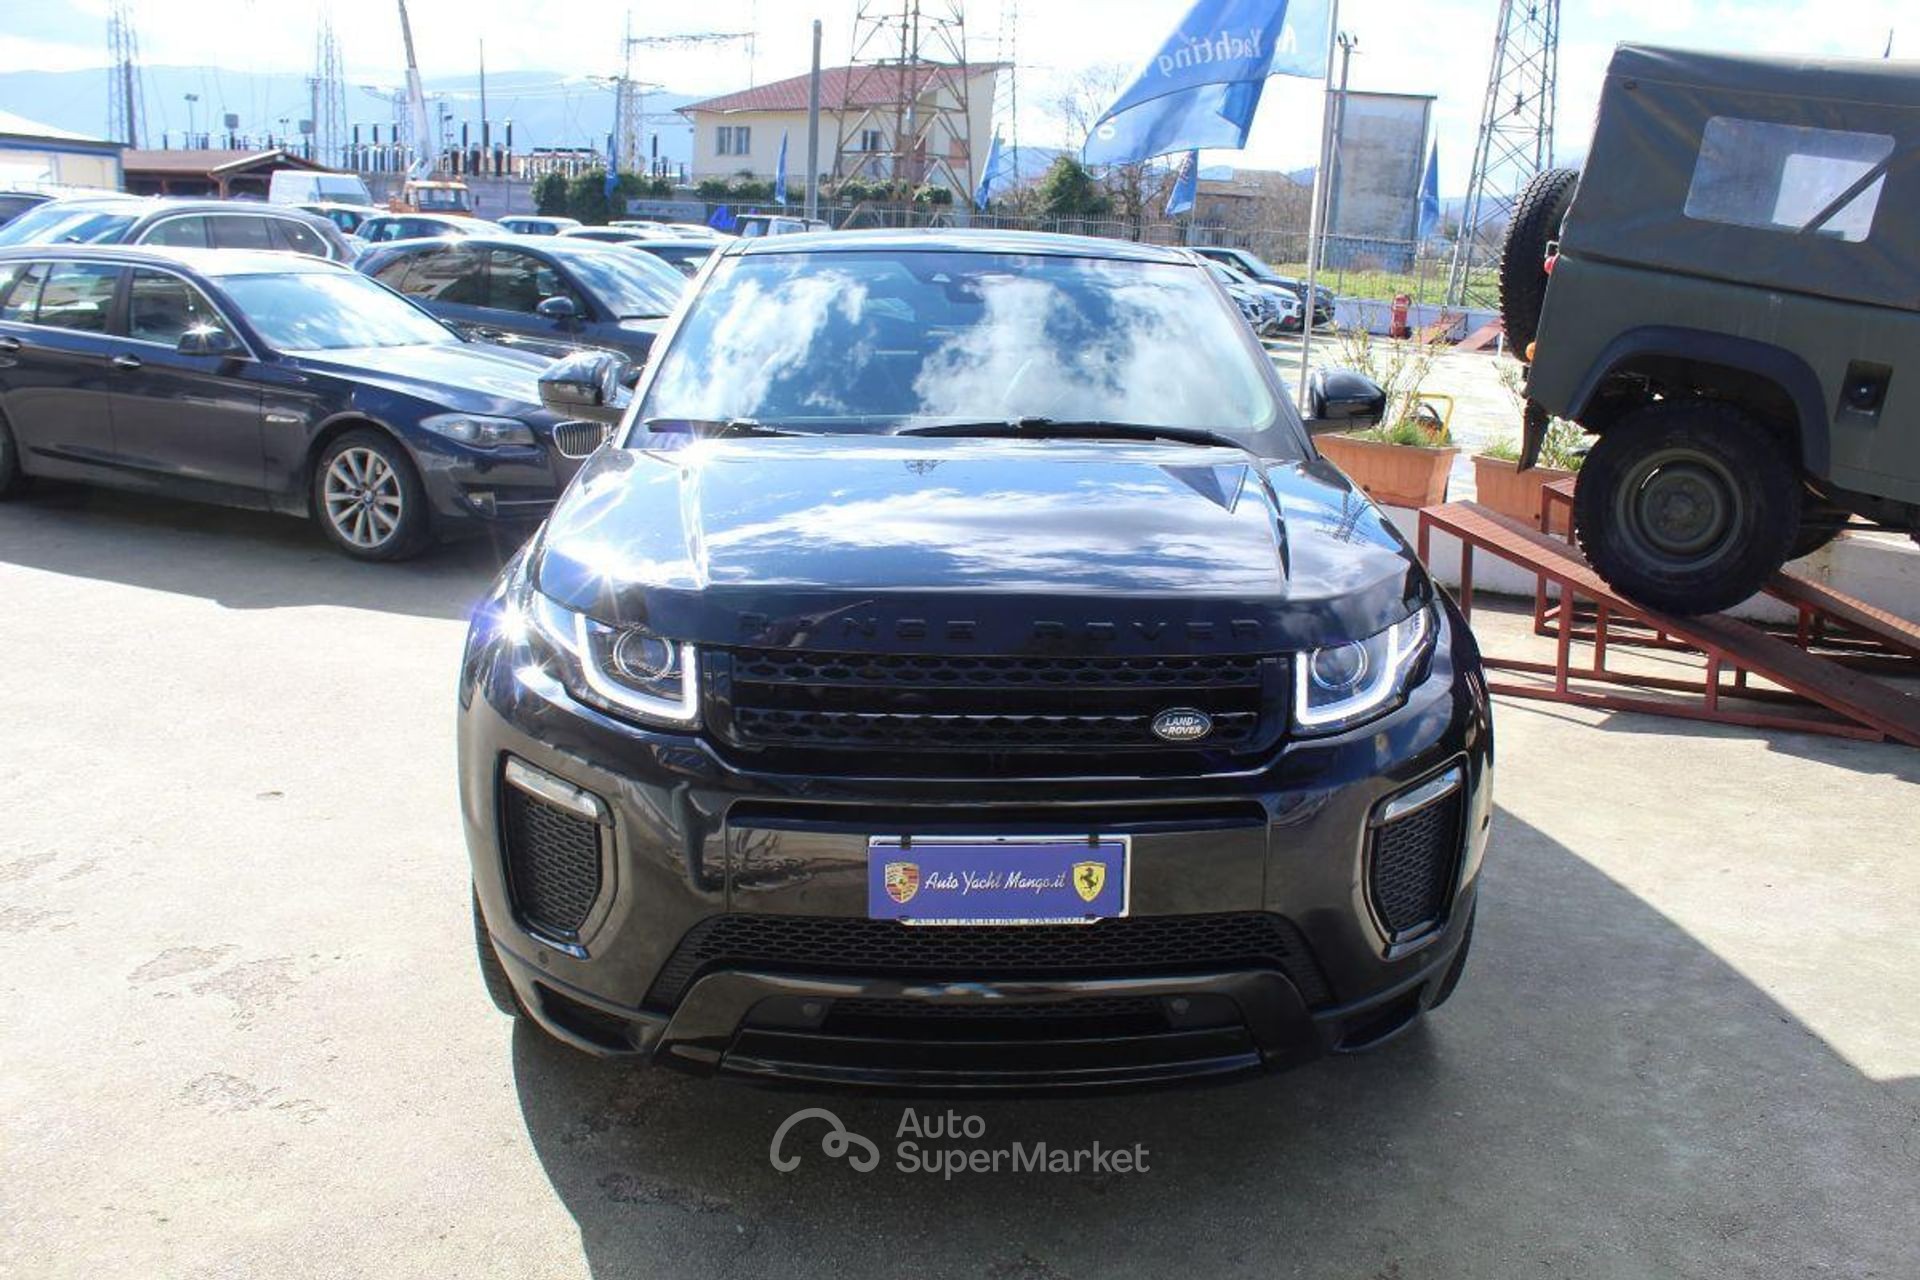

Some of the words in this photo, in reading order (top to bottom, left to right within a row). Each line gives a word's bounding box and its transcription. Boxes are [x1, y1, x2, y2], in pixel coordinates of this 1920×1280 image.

[737, 612, 976, 641] RNGE
[1033, 618, 1263, 642] ROVER
[1165, 716, 1194, 726] LAND
[1167, 726, 1202, 735] ROVER
[924, 871, 959, 890] Auto
[1004, 870, 1066, 895] Mango.it
